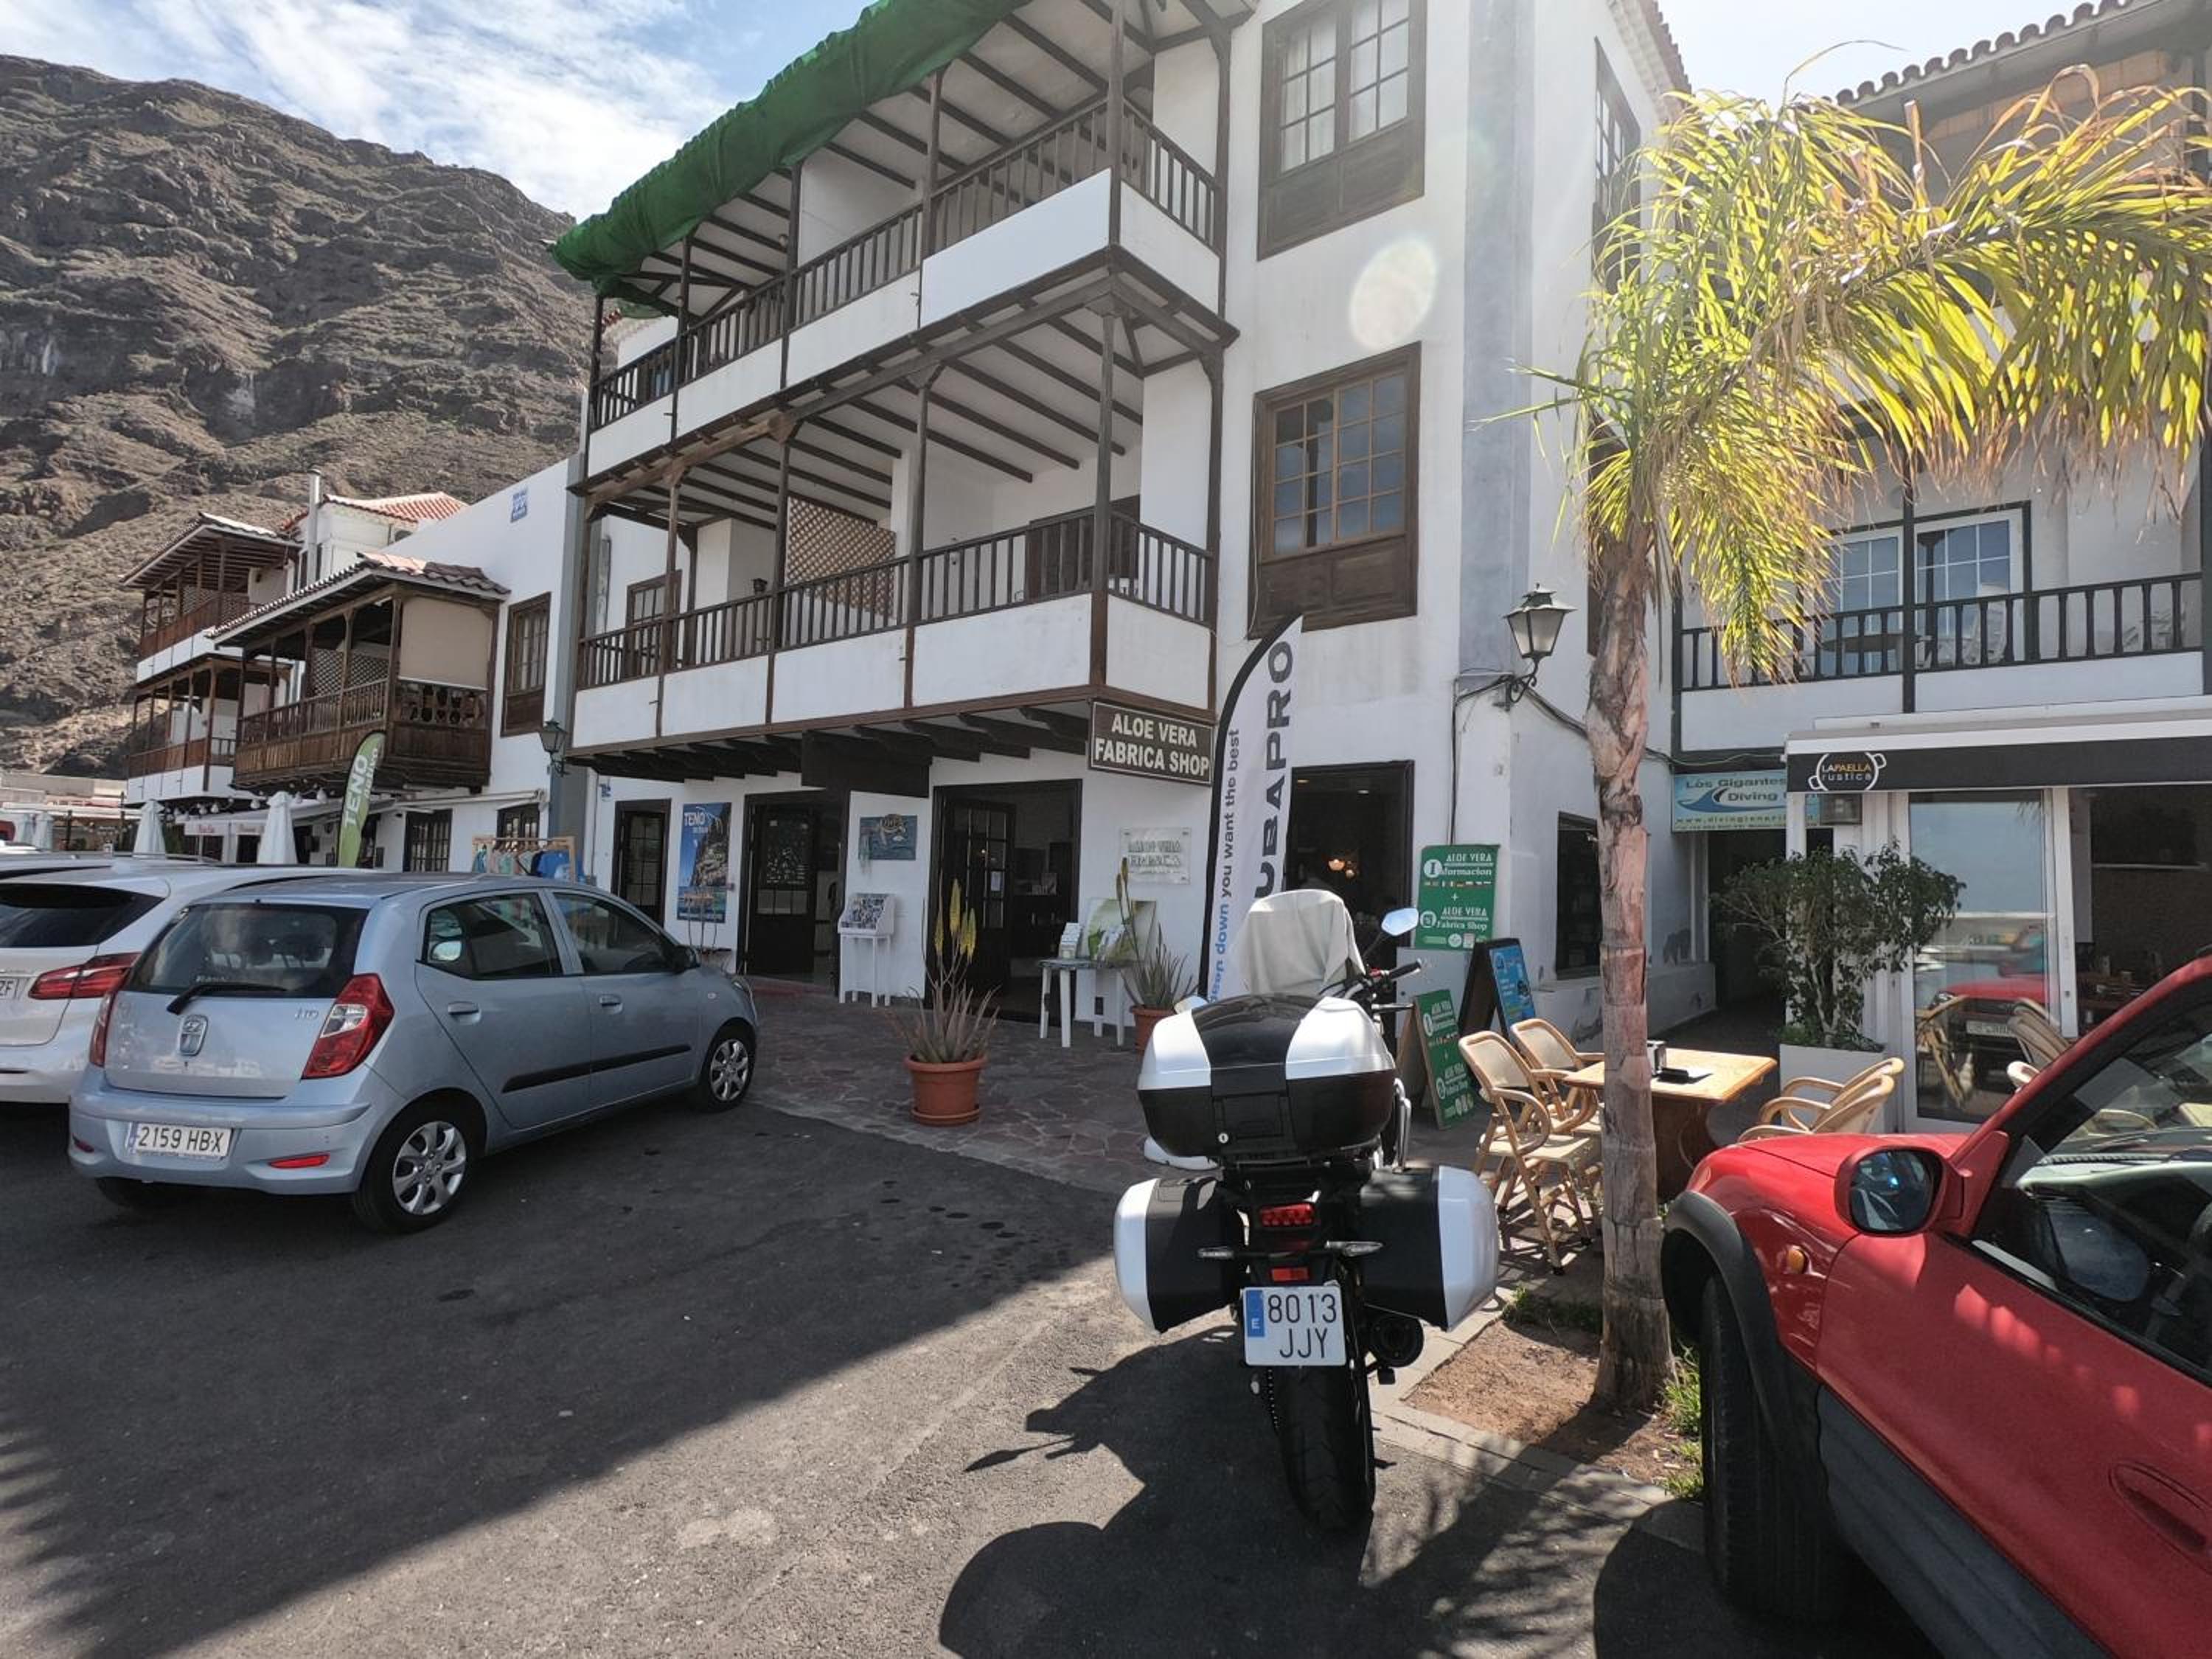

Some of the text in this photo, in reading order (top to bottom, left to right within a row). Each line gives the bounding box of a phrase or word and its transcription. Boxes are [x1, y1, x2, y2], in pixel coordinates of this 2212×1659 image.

[1111, 713, 1197, 748] ALOE VERA
[1095, 737, 1210, 776] FABRICA SHOP
[1226, 728, 1239, 771] best
[343, 754, 369, 827] TENO
[1225, 776, 1237, 807] the
[1686, 777, 1787, 788] Los Gigantes
[1728, 792, 1778, 801] Diving
[684, 812, 706, 827] TENO
[1224, 812, 1235, 860] want
[1446, 853, 1492, 863] ALOE VERA
[1220, 865, 1233, 898] you
[1441, 907, 1487, 917] ALOE VERA
[1467, 921, 1487, 932] Shop
[1214, 903, 1229, 955] down
[139, 1126, 223, 1152] 2159 HBX
[1268, 1294, 1337, 1324] 8013
[1279, 1328, 1328, 1359] JJY
